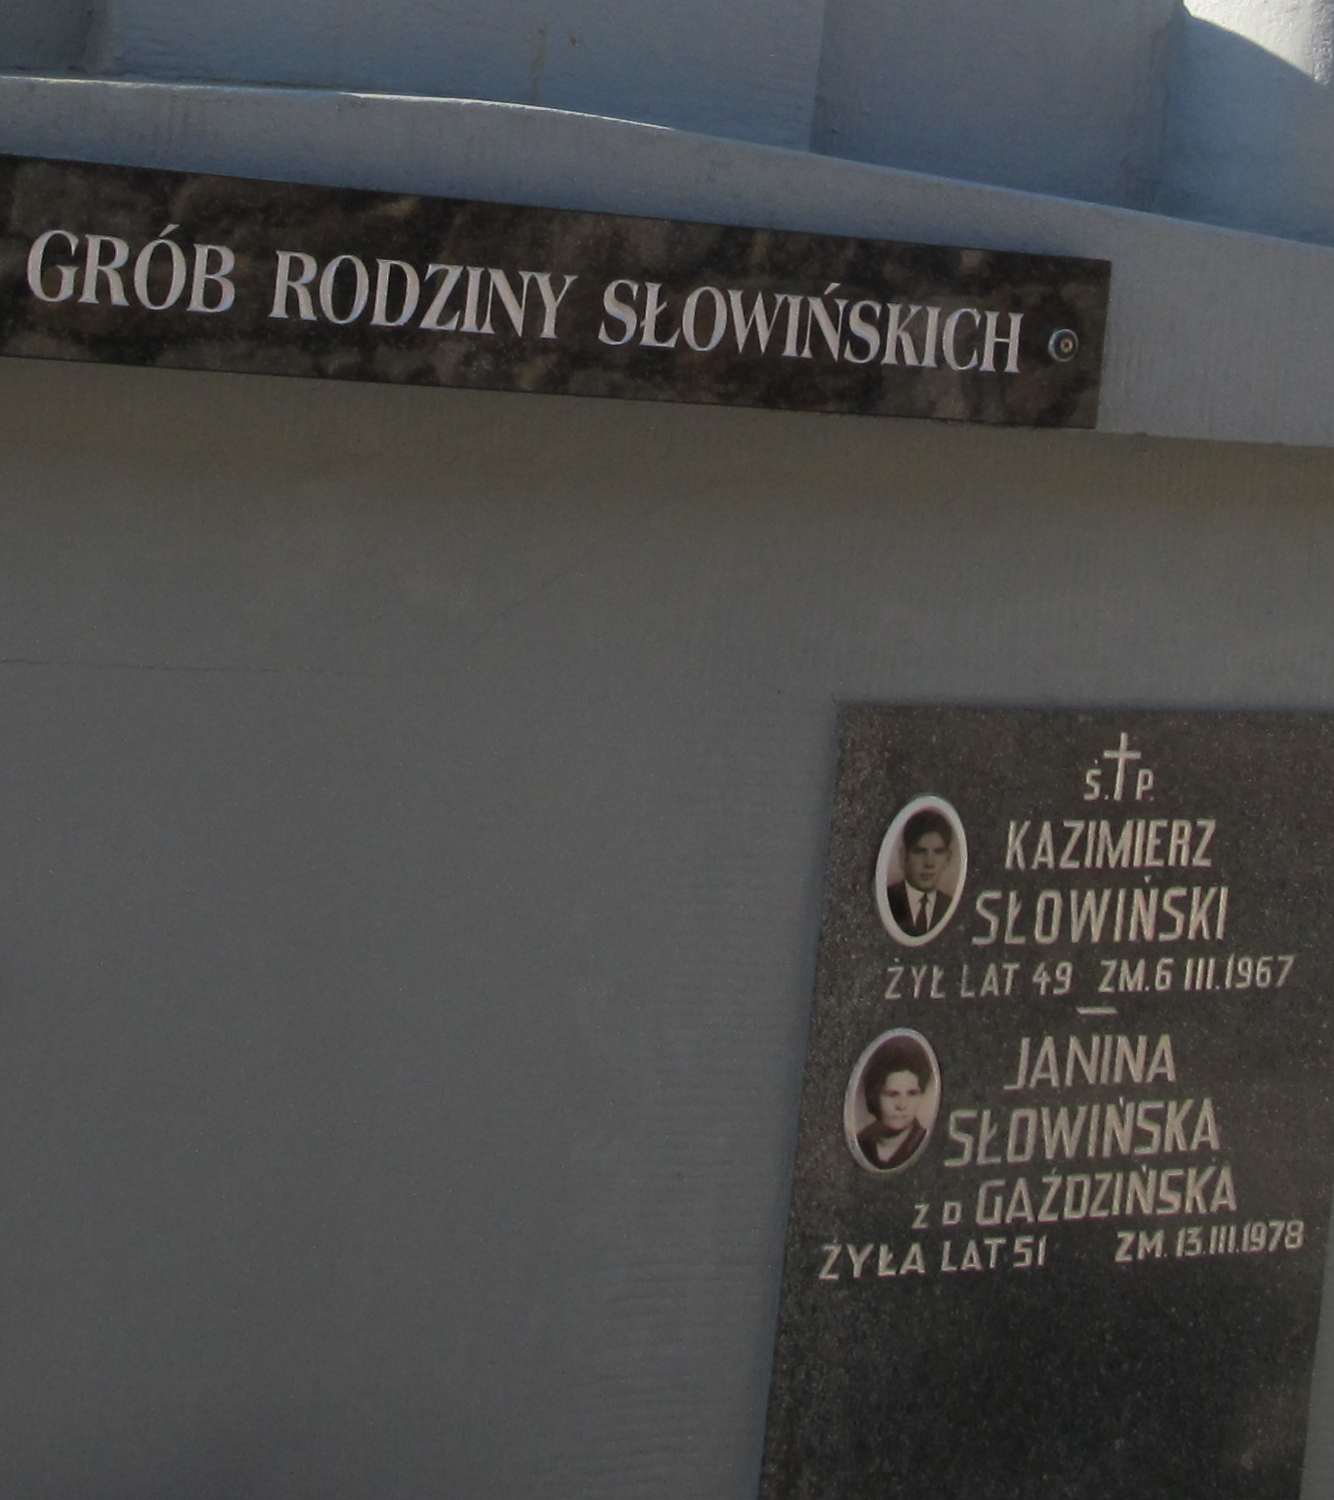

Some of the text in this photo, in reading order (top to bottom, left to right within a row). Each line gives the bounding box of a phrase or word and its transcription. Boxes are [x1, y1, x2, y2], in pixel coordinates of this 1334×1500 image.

[25, 223, 1024, 374] GRÓB RODZINY SŁOWIŃSKICH
[1004, 819, 1216, 871] KAZIMIERZ
[971, 875, 1229, 947] SŁOWIŃSKI
[960, 962, 1020, 998] LAT
[1032, 961, 1074, 996] 49
[1004, 1033, 1177, 1091] JANINA
[943, 1096, 1221, 1168] SŁOWIŃSKA
[975, 1164, 1238, 1227] GAŹDZIŃSKA
[818, 1237, 926, 1281] ŻYŁA
[940, 1237, 1007, 1272] LAT
[1012, 1234, 1047, 1268] 51
